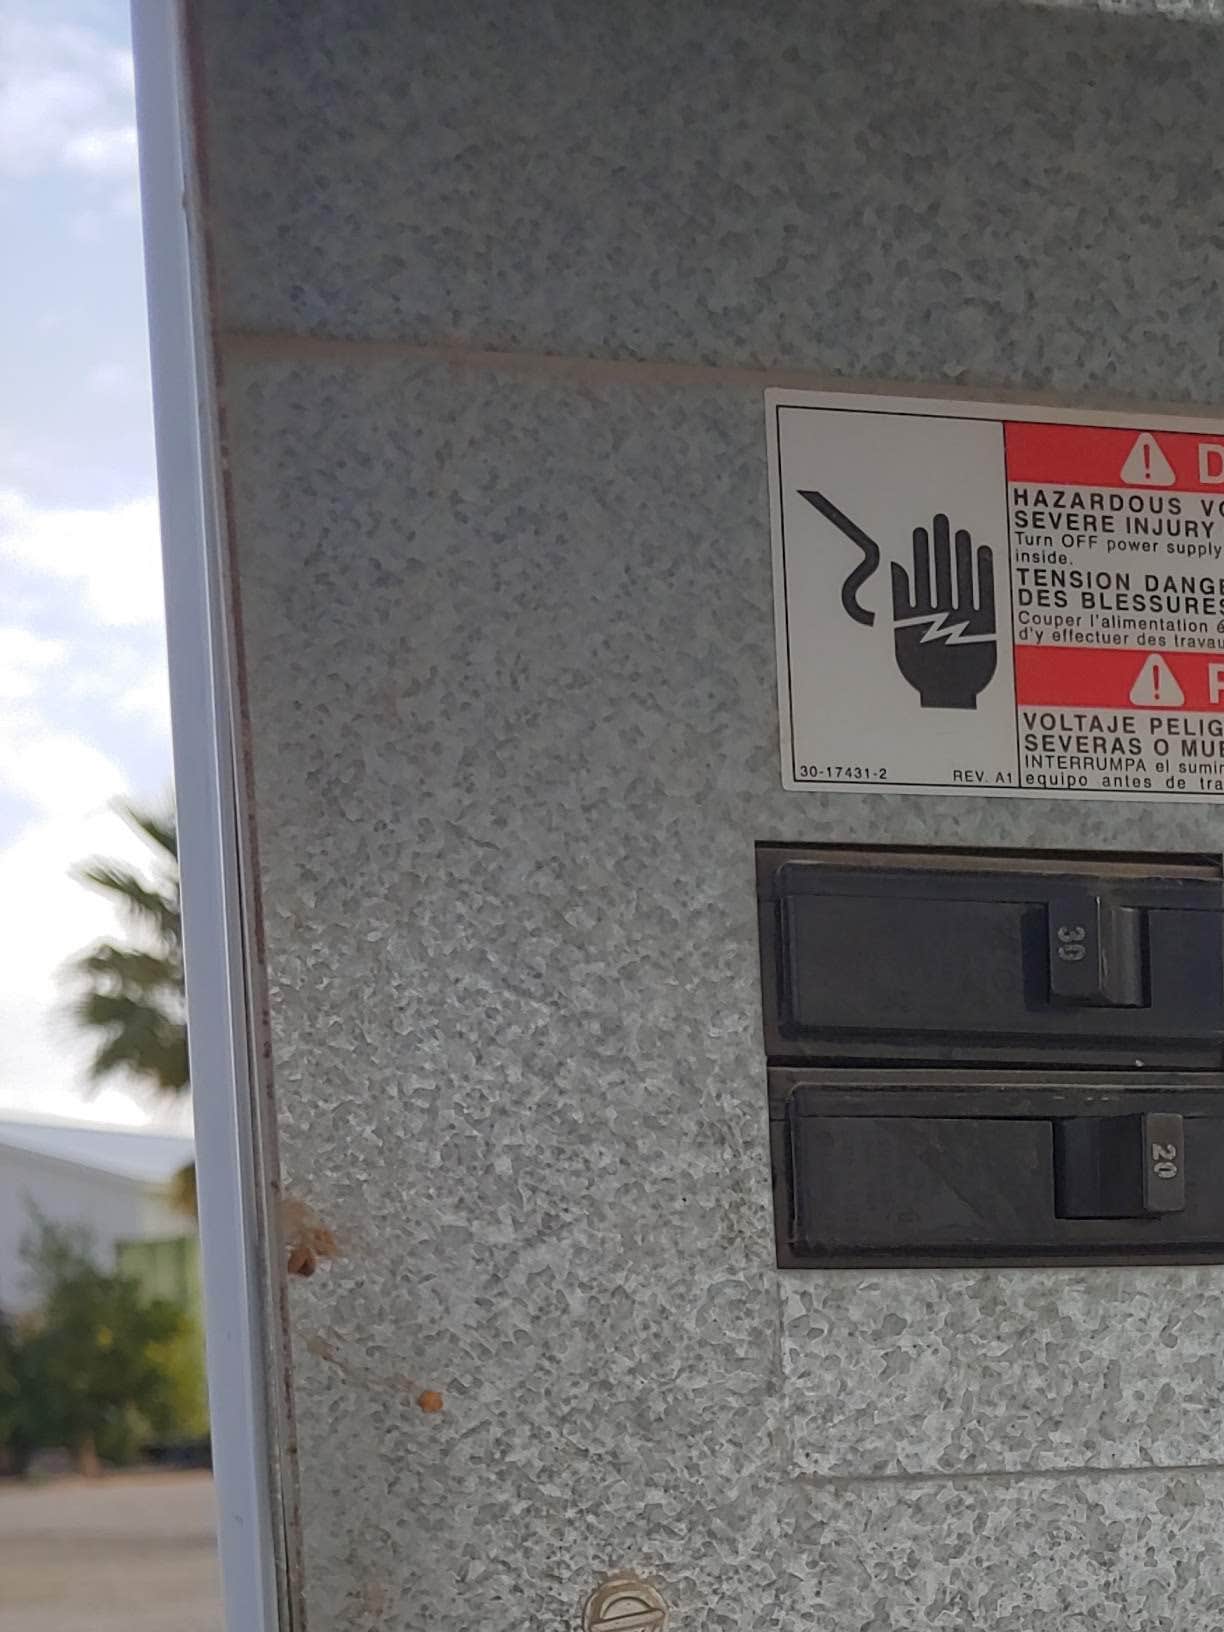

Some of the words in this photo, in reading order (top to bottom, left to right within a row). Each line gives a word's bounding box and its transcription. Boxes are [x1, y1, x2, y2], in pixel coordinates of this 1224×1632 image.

[1014, 487, 1182, 515] HAZARDOUS
[1014, 510, 1115, 533] SEVERE
[1126, 516, 1215, 538] INJURY
[1014, 531, 1053, 547] Turn
[1062, 534, 1098, 549] OFF
[1107, 538, 1158, 553] power
[1015, 550, 1073, 566] inside.
[1017, 567, 1130, 591] TENSION
[1018, 589, 1068, 608] DES
[1018, 610, 1081, 629] Couper
[1090, 614, 1208, 632] l'alimentation
[1019, 628, 1044, 644] d'y
[1052, 630, 1129, 645] effectuer
[1137, 632, 1166, 647] des
[1023, 712, 1135, 734] VOLTAJE
[1024, 734, 1142, 755] SEVERAS
[1154, 738, 1169, 755] O
[800, 765, 887, 779] 30-17431-2
[1025, 755, 1147, 772] INTERRUMPA
[1156, 760, 1169, 773] el
[953, 769, 988, 783] REV.
[995, 771, 1013, 784] A1
[1026, 773, 1088, 789] equipo
[1102, 774, 1151, 788] antes
[1167, 777, 1186, 789] de
[1057, 926, 1086, 961] 30
[1152, 1143, 1177, 1179] 20
